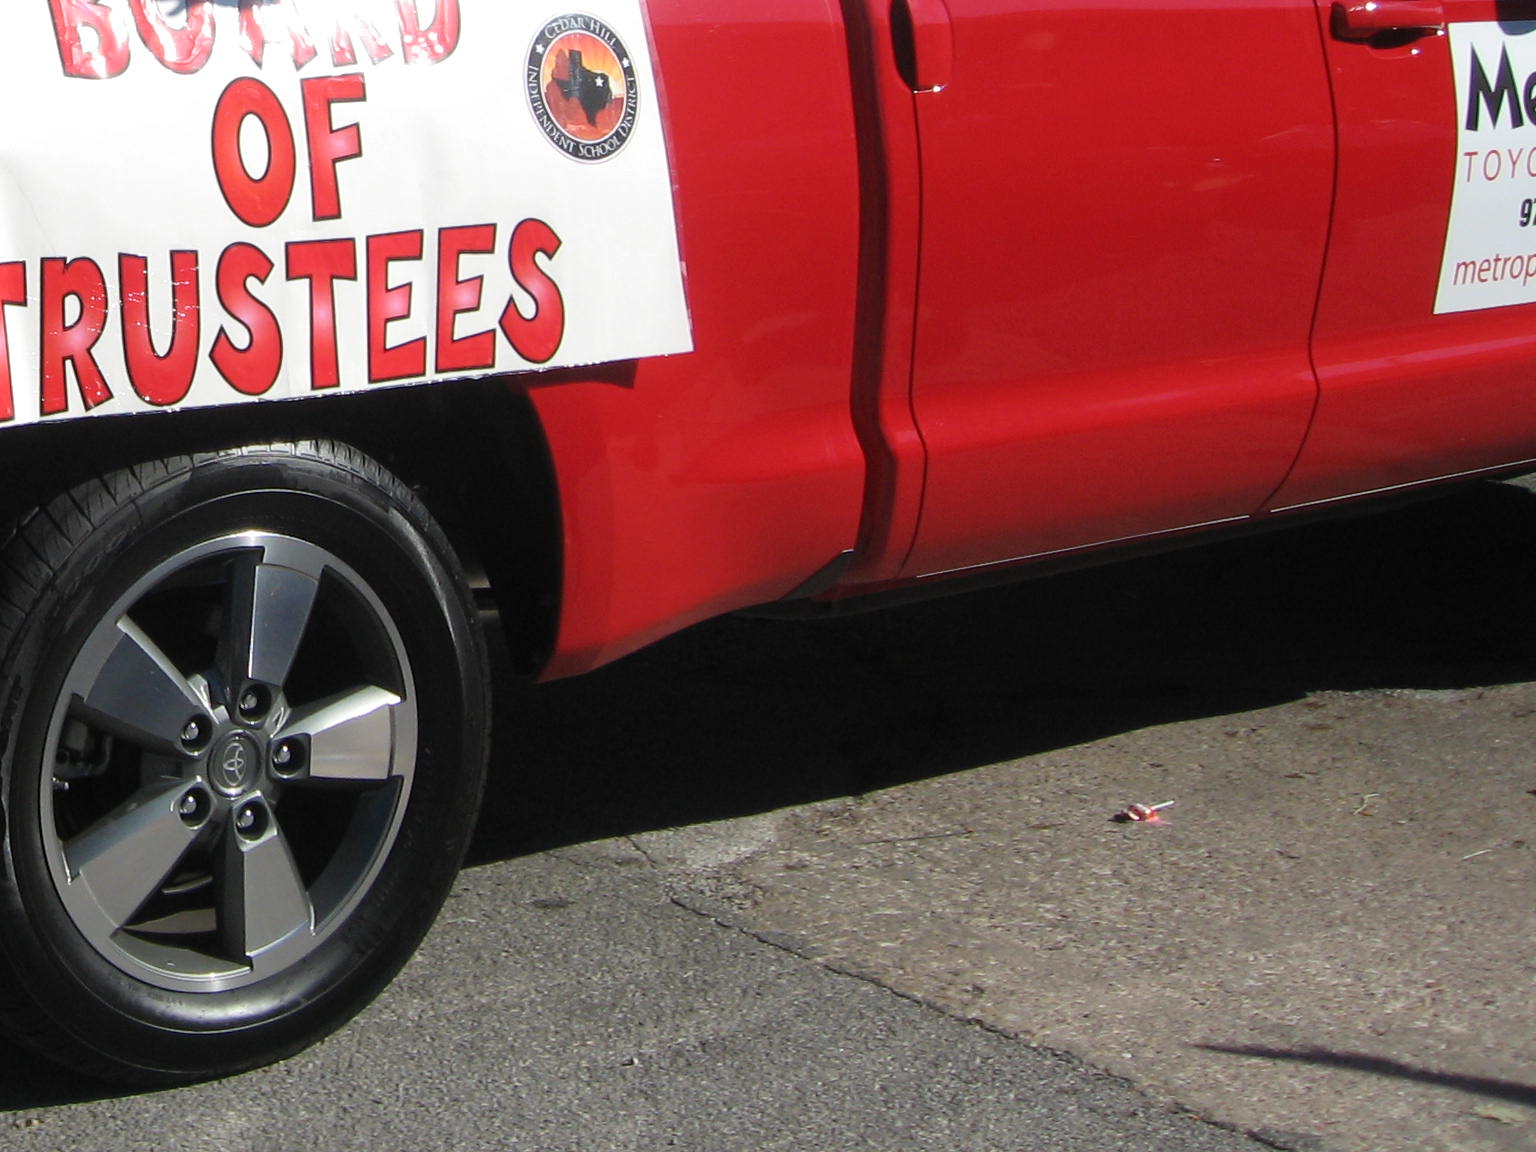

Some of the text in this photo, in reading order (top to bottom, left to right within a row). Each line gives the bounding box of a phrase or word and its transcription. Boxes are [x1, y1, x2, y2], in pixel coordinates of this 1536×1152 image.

[544, 17, 617, 46] CEDAR HILL
[528, 65, 638, 158] INDEPENDENT SCHOOL DISTRICT
[1465, 40, 1536, 132] Me
[211, 71, 368, 228] OF
[1453, 253, 1536, 287] metrop
